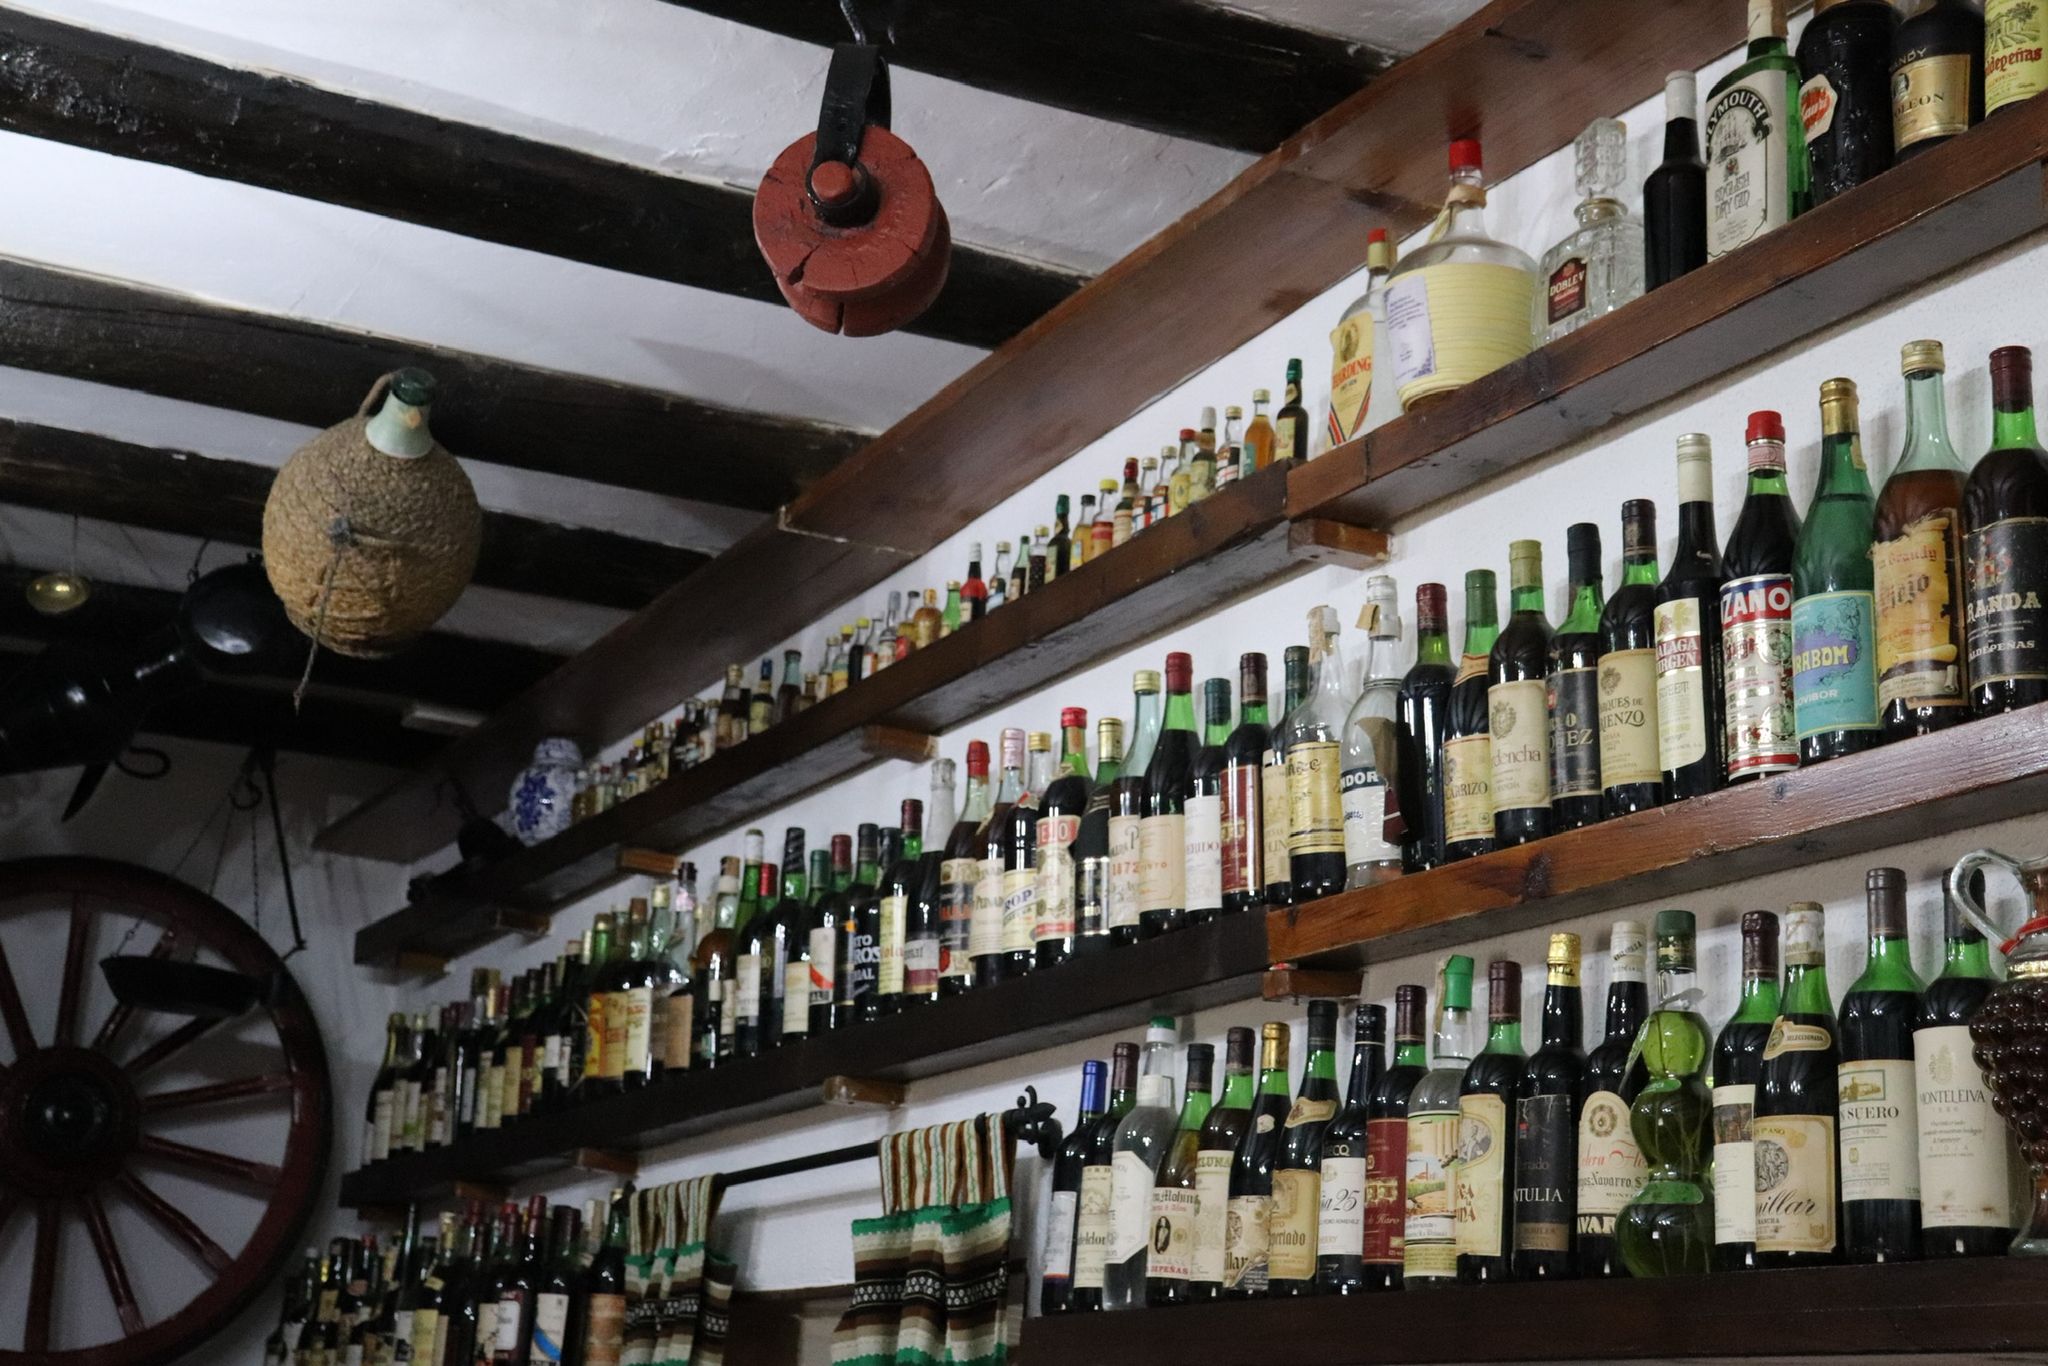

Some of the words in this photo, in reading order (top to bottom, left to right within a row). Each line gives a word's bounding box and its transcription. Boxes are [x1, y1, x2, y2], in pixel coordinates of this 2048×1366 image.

[1549, 273, 1579, 297] DOBLE
[1720, 586, 1791, 625] ZANO
[1847, 1106, 1900, 1121] SUERO
[1333, 1188, 1361, 1212] 25
